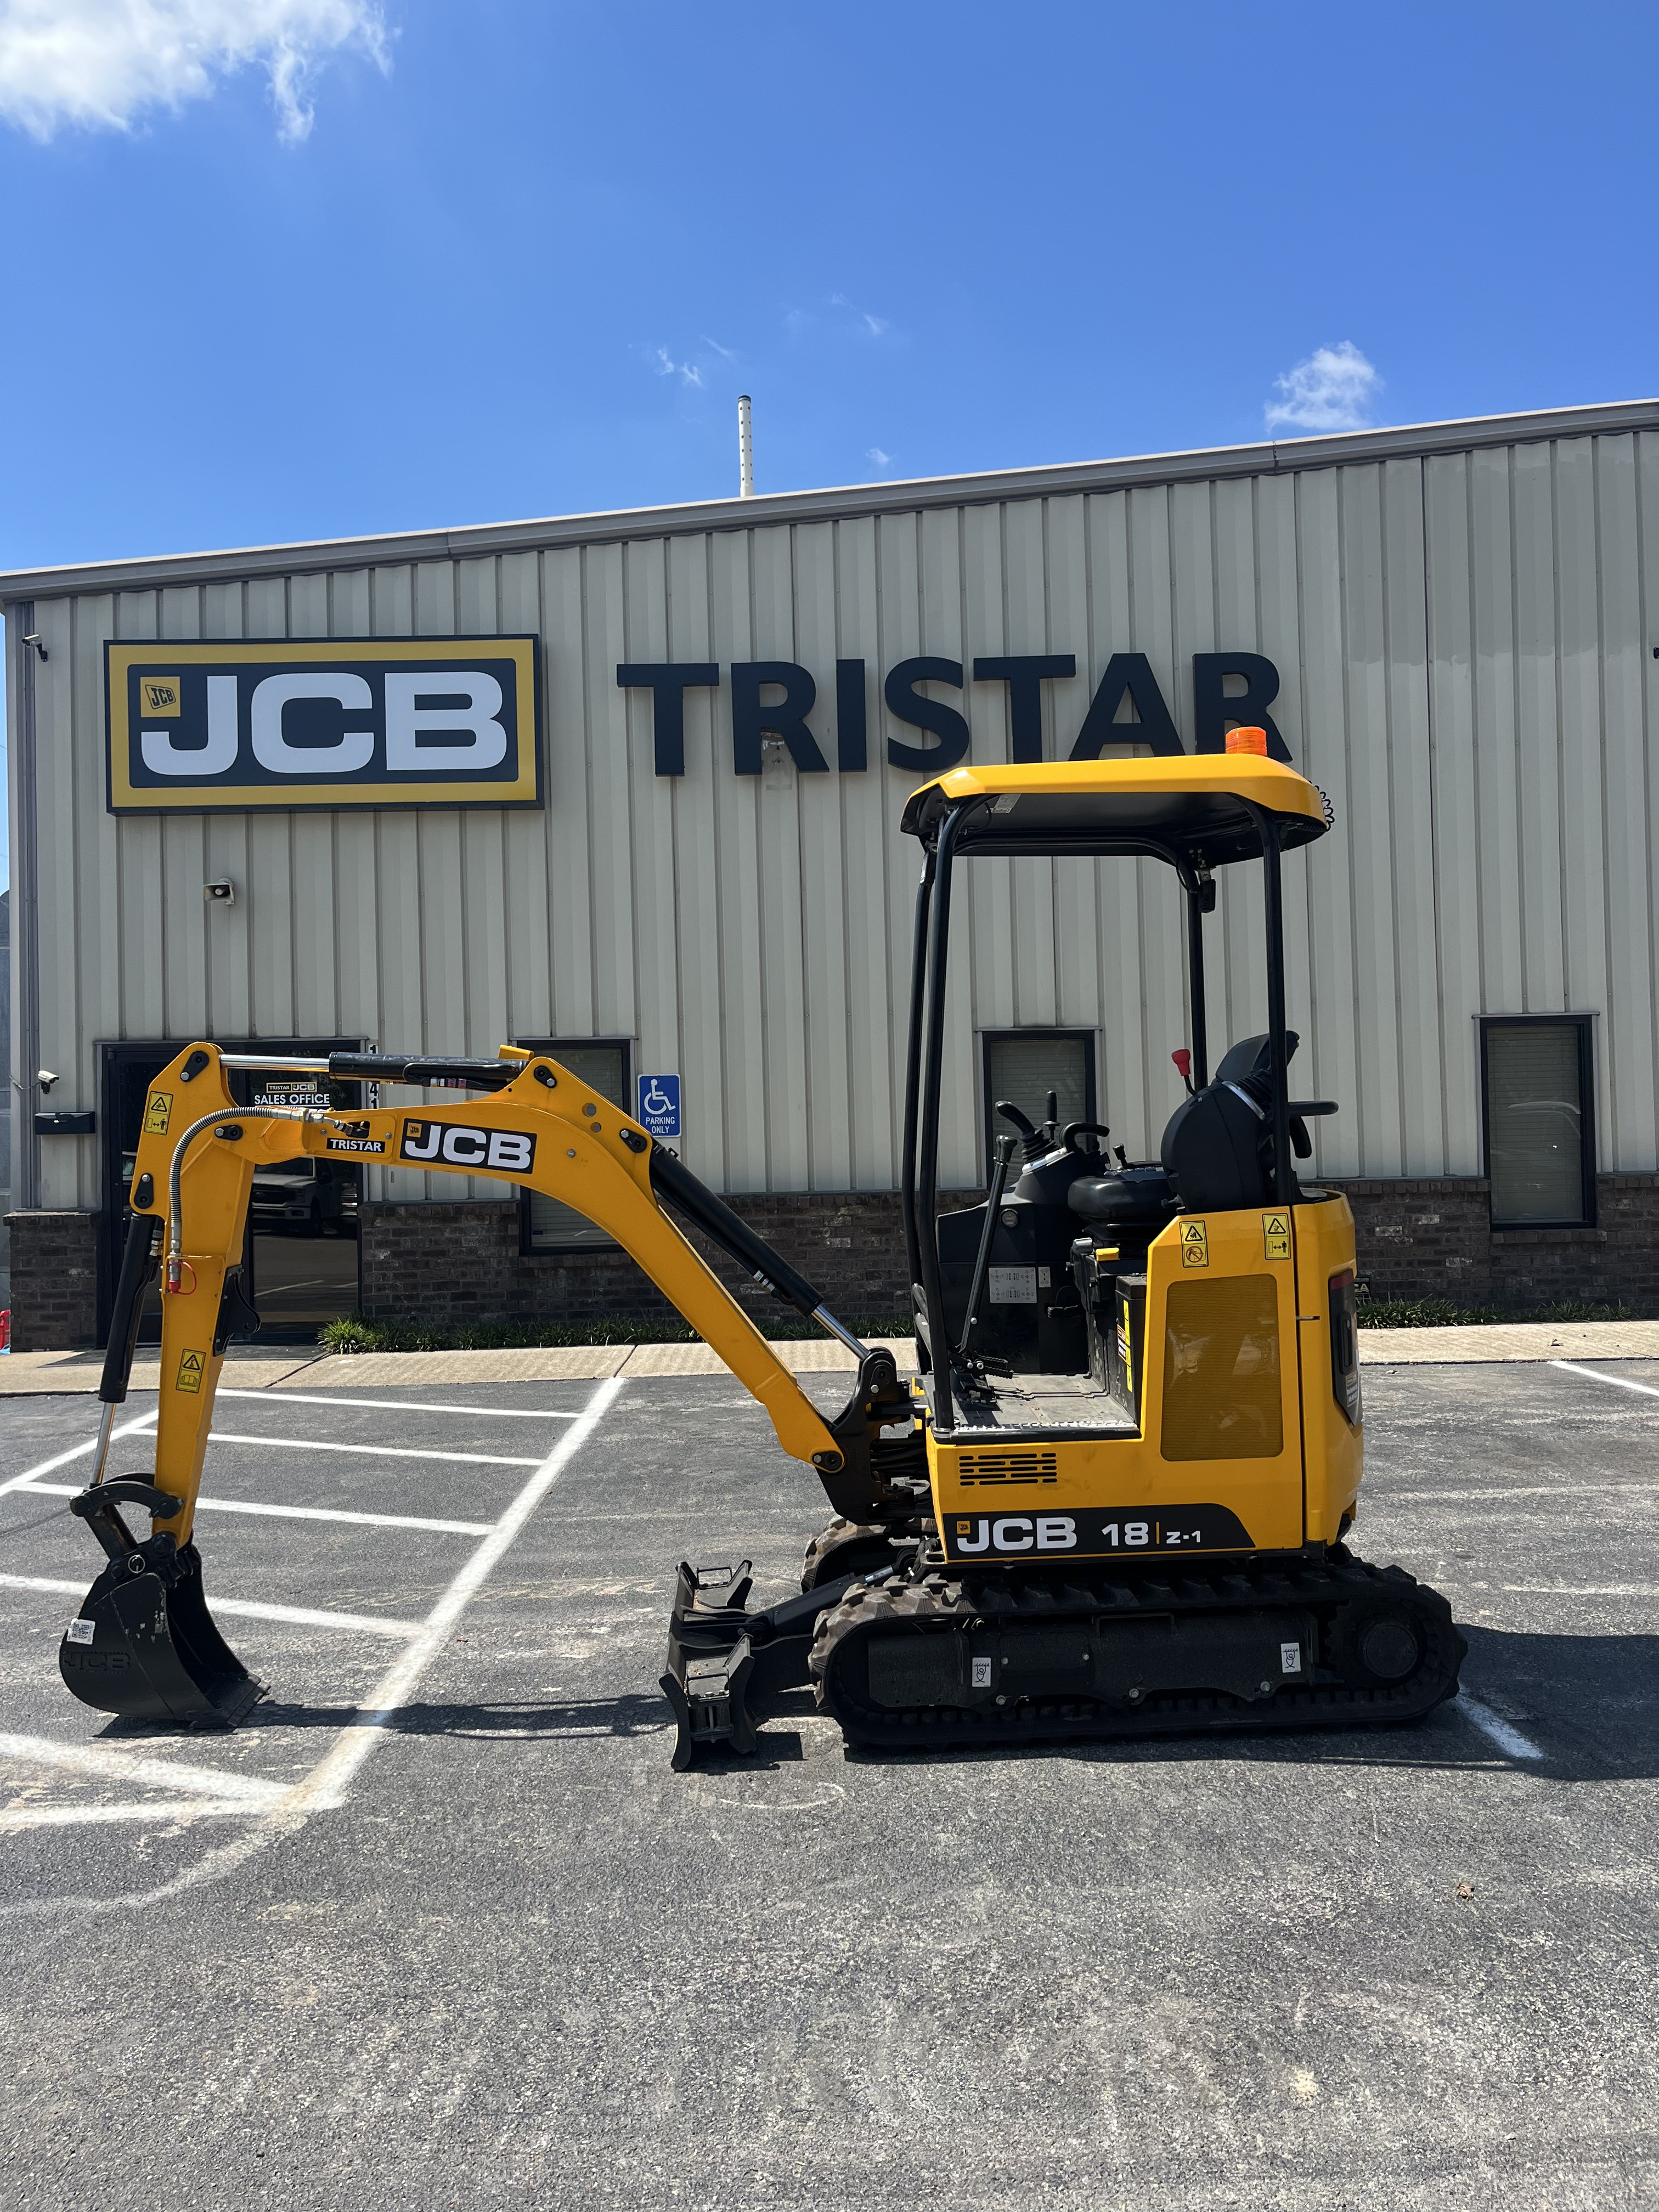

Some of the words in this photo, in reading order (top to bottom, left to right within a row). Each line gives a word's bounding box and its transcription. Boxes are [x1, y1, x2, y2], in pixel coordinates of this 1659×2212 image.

[150, 687, 174, 707] JCB
[141, 671, 507, 776] JCB
[616, 653, 1294, 777] TRISTAR
[254, 1094, 286, 1105] SALES
[289, 1093, 330, 1104] OFFICE
[645, 1116, 675, 1125] PARKING
[651, 1125, 670, 1133] ONLY
[330, 1139, 382, 1152] TRISTAR
[405, 1125, 532, 1169] JCB
[957, 1517, 1077, 1552] JCB
[1101, 1522, 1149, 1546] 18
